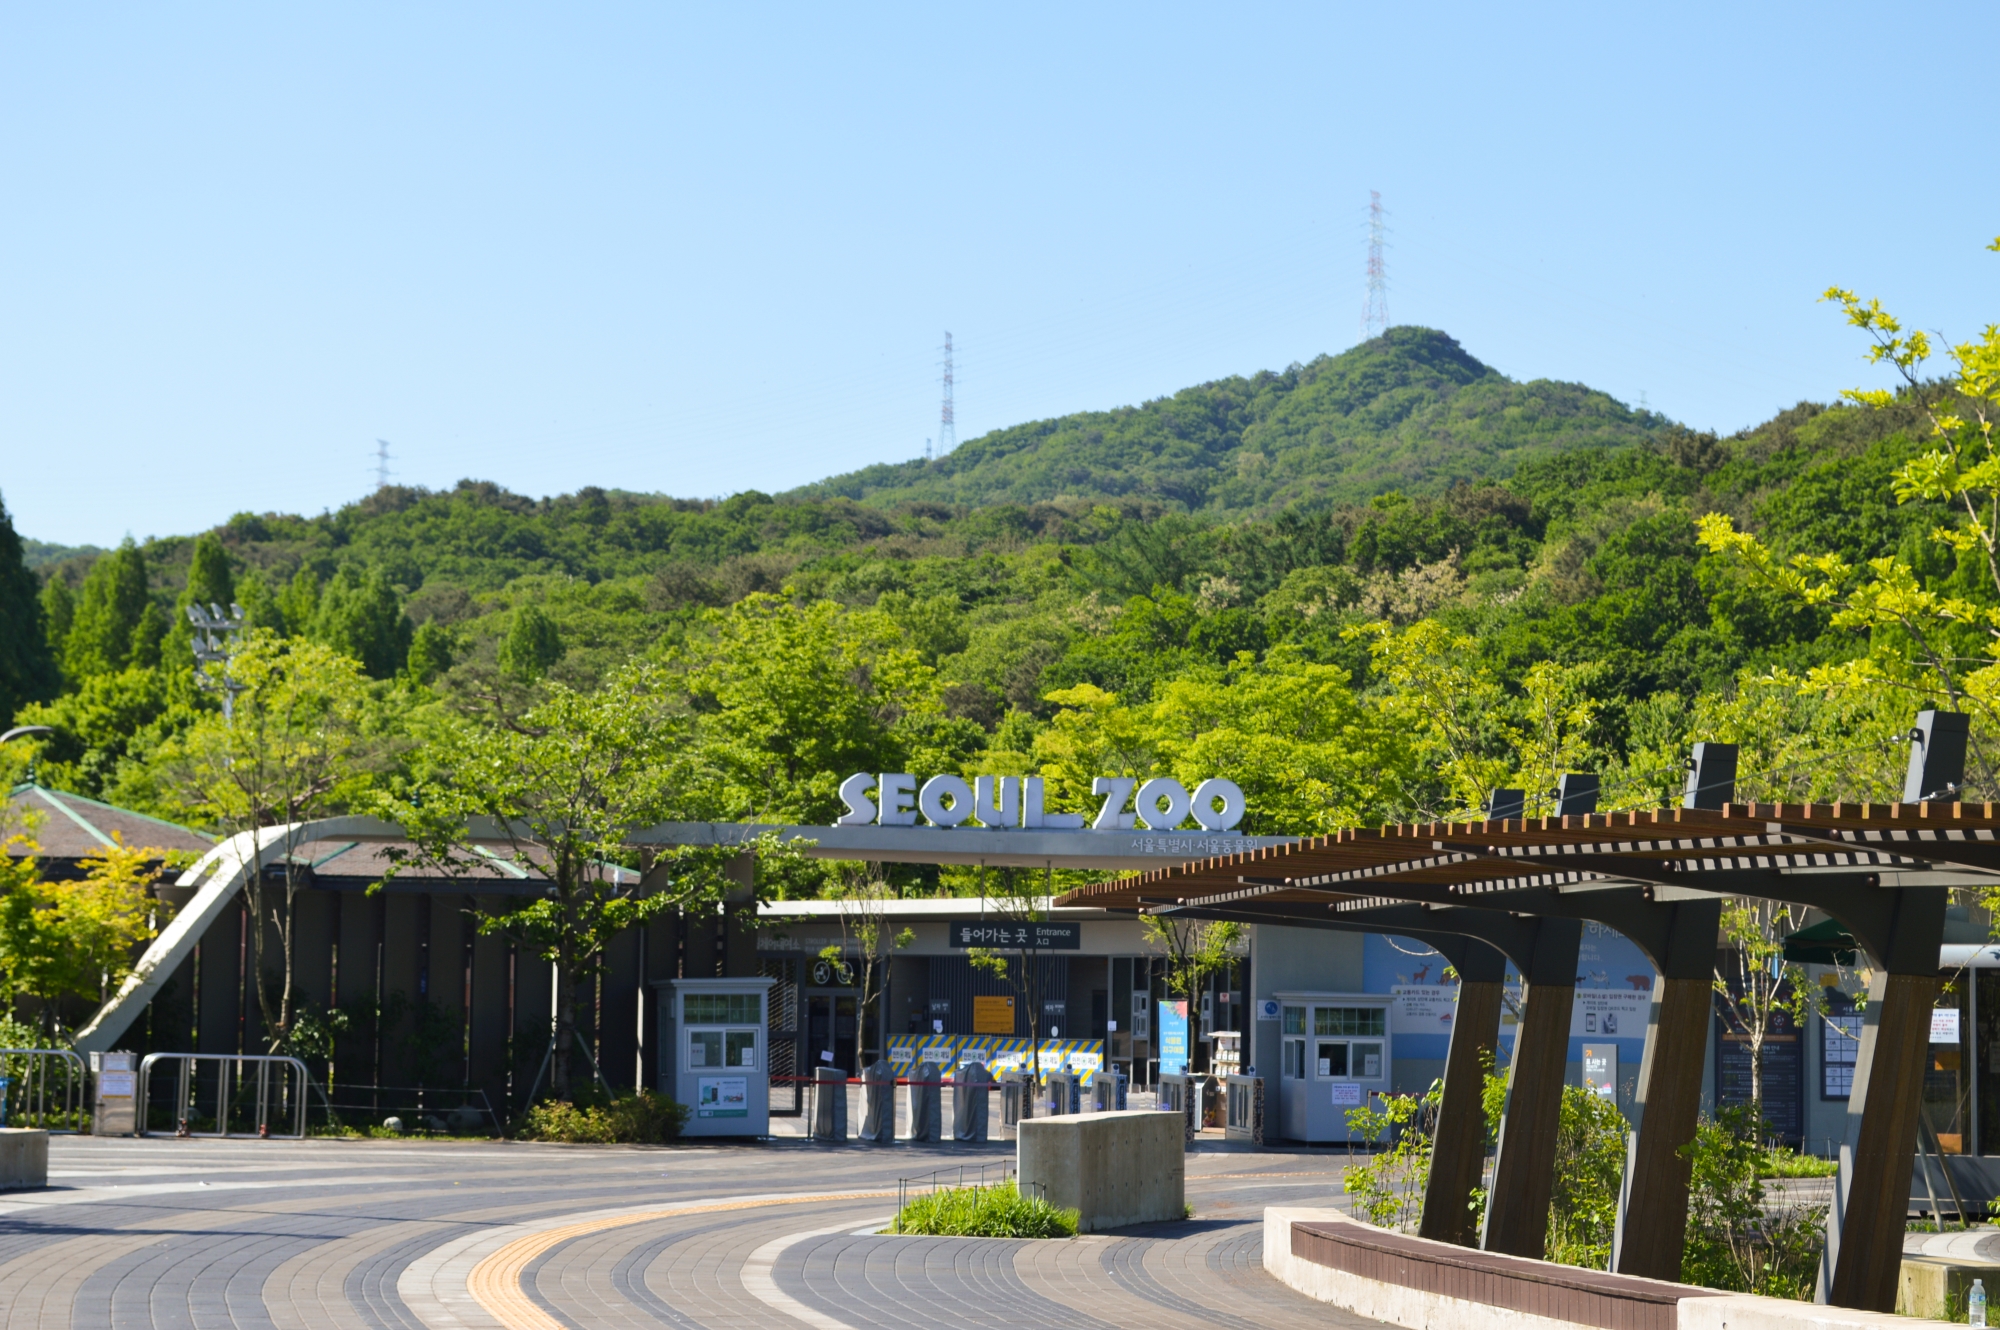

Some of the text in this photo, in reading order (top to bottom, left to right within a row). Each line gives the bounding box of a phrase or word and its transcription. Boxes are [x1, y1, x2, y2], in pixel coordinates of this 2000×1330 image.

[834, 771, 1247, 831] SEOUL ZOO
[960, 927, 1028, 943] 들어가는 곳
[1036, 927, 1071, 937] Entrance
